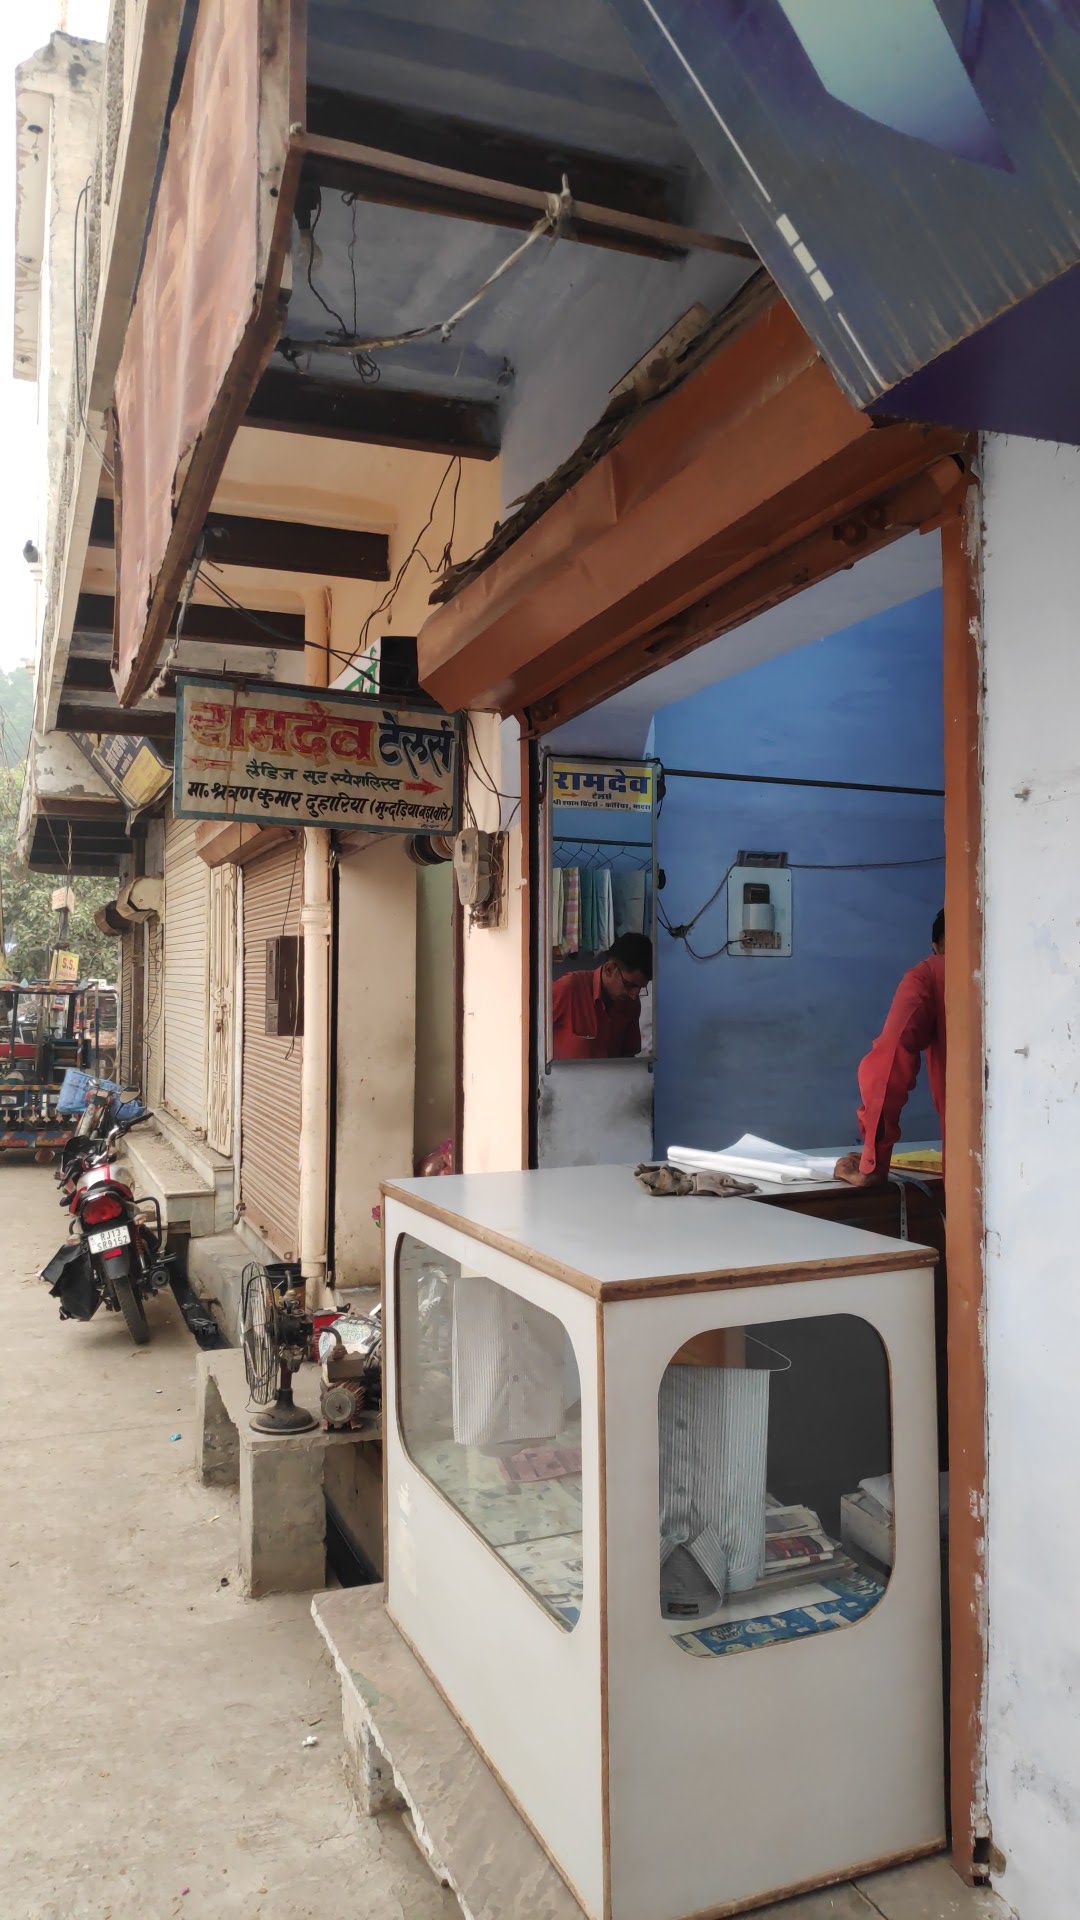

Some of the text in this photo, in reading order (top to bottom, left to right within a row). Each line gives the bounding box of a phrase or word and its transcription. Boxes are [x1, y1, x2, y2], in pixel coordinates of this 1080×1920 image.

[189, 700, 379, 767] रामदेव
[378, 710, 459, 779] टेलर्स
[302, 770, 329, 786] सूट
[553, 769, 651, 794] रामदेव
[257, 788, 303, 811] कुमार
[61, 957, 75, 971] S.S.
[100, 1228, 121, 1241] RJ13
[96, 1235, 129, 1251] SR9152
